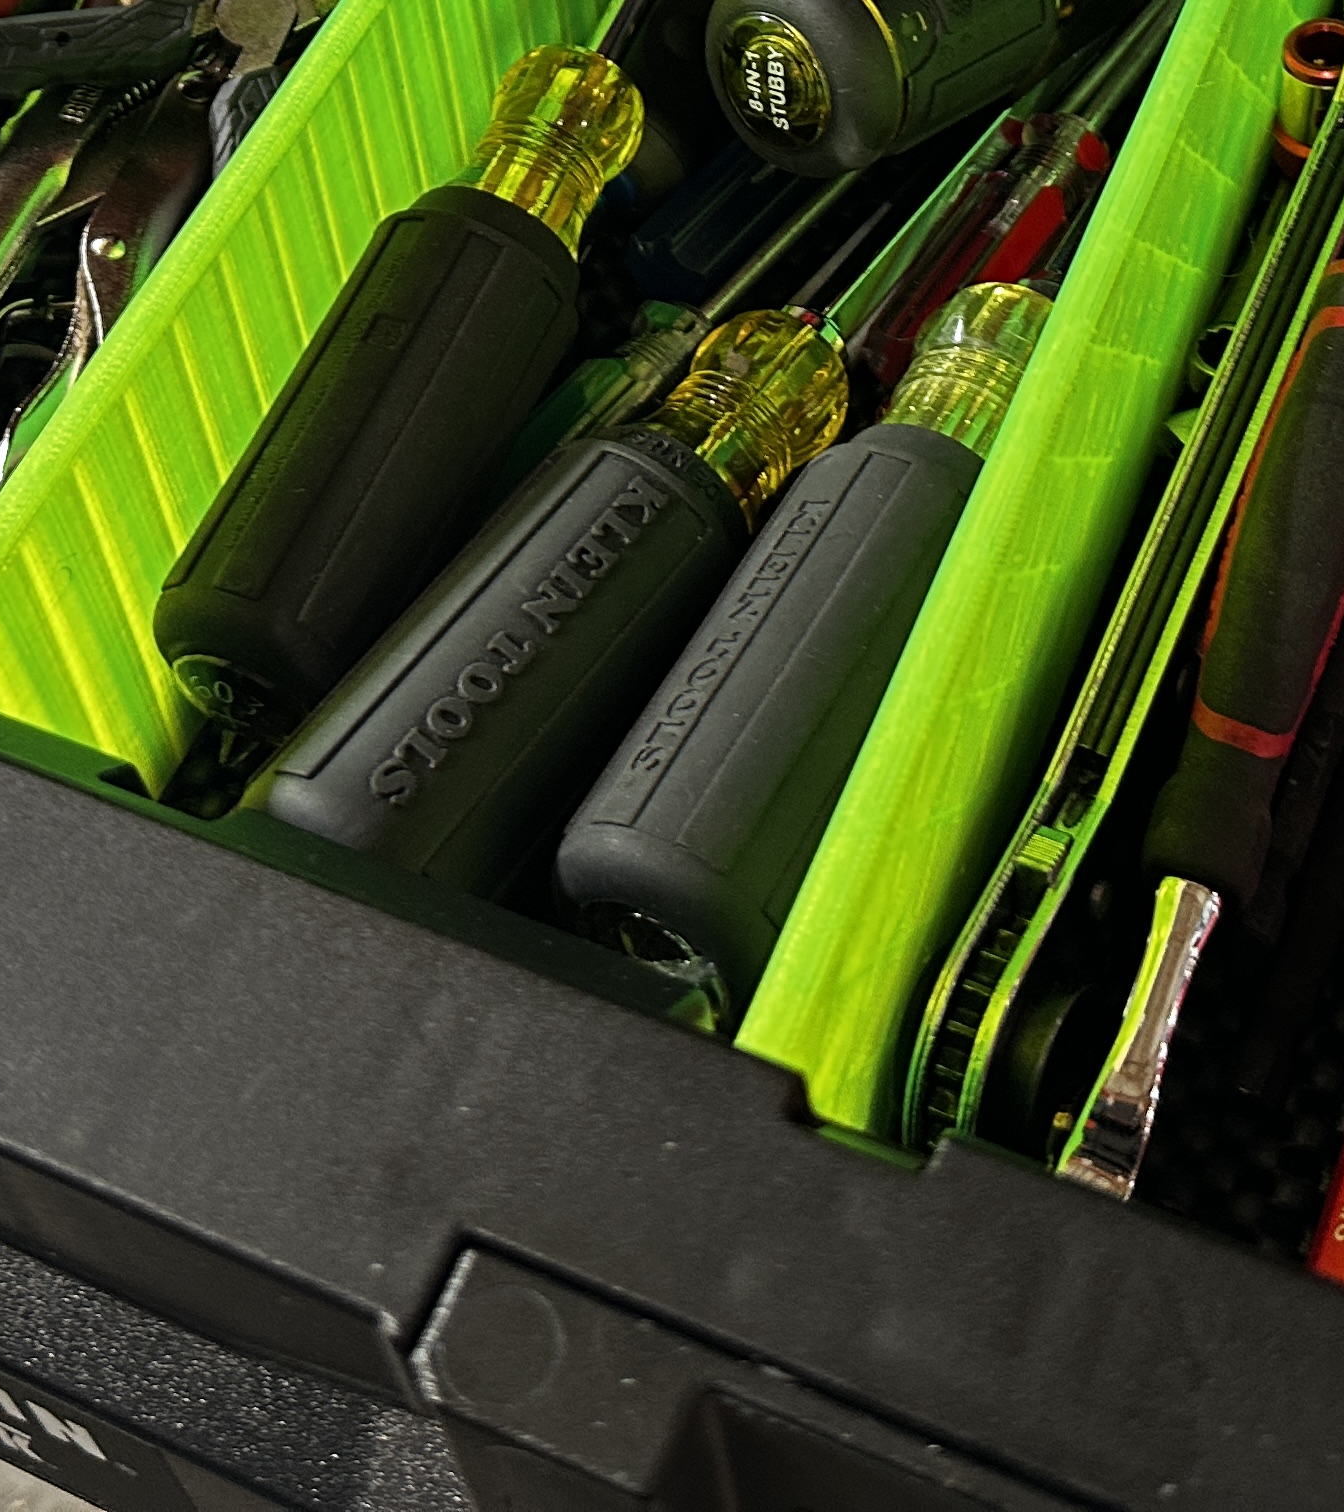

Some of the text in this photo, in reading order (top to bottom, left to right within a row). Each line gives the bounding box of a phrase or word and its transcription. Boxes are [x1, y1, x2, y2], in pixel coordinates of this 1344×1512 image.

[744, 50, 765, 113] 8-IN-1
[767, 45, 790, 131] STUBBY
[729, 496, 832, 624] KLEIN
[370, 475, 672, 807] KLEIN TOOLS
[632, 629, 739, 775] TOOLS
